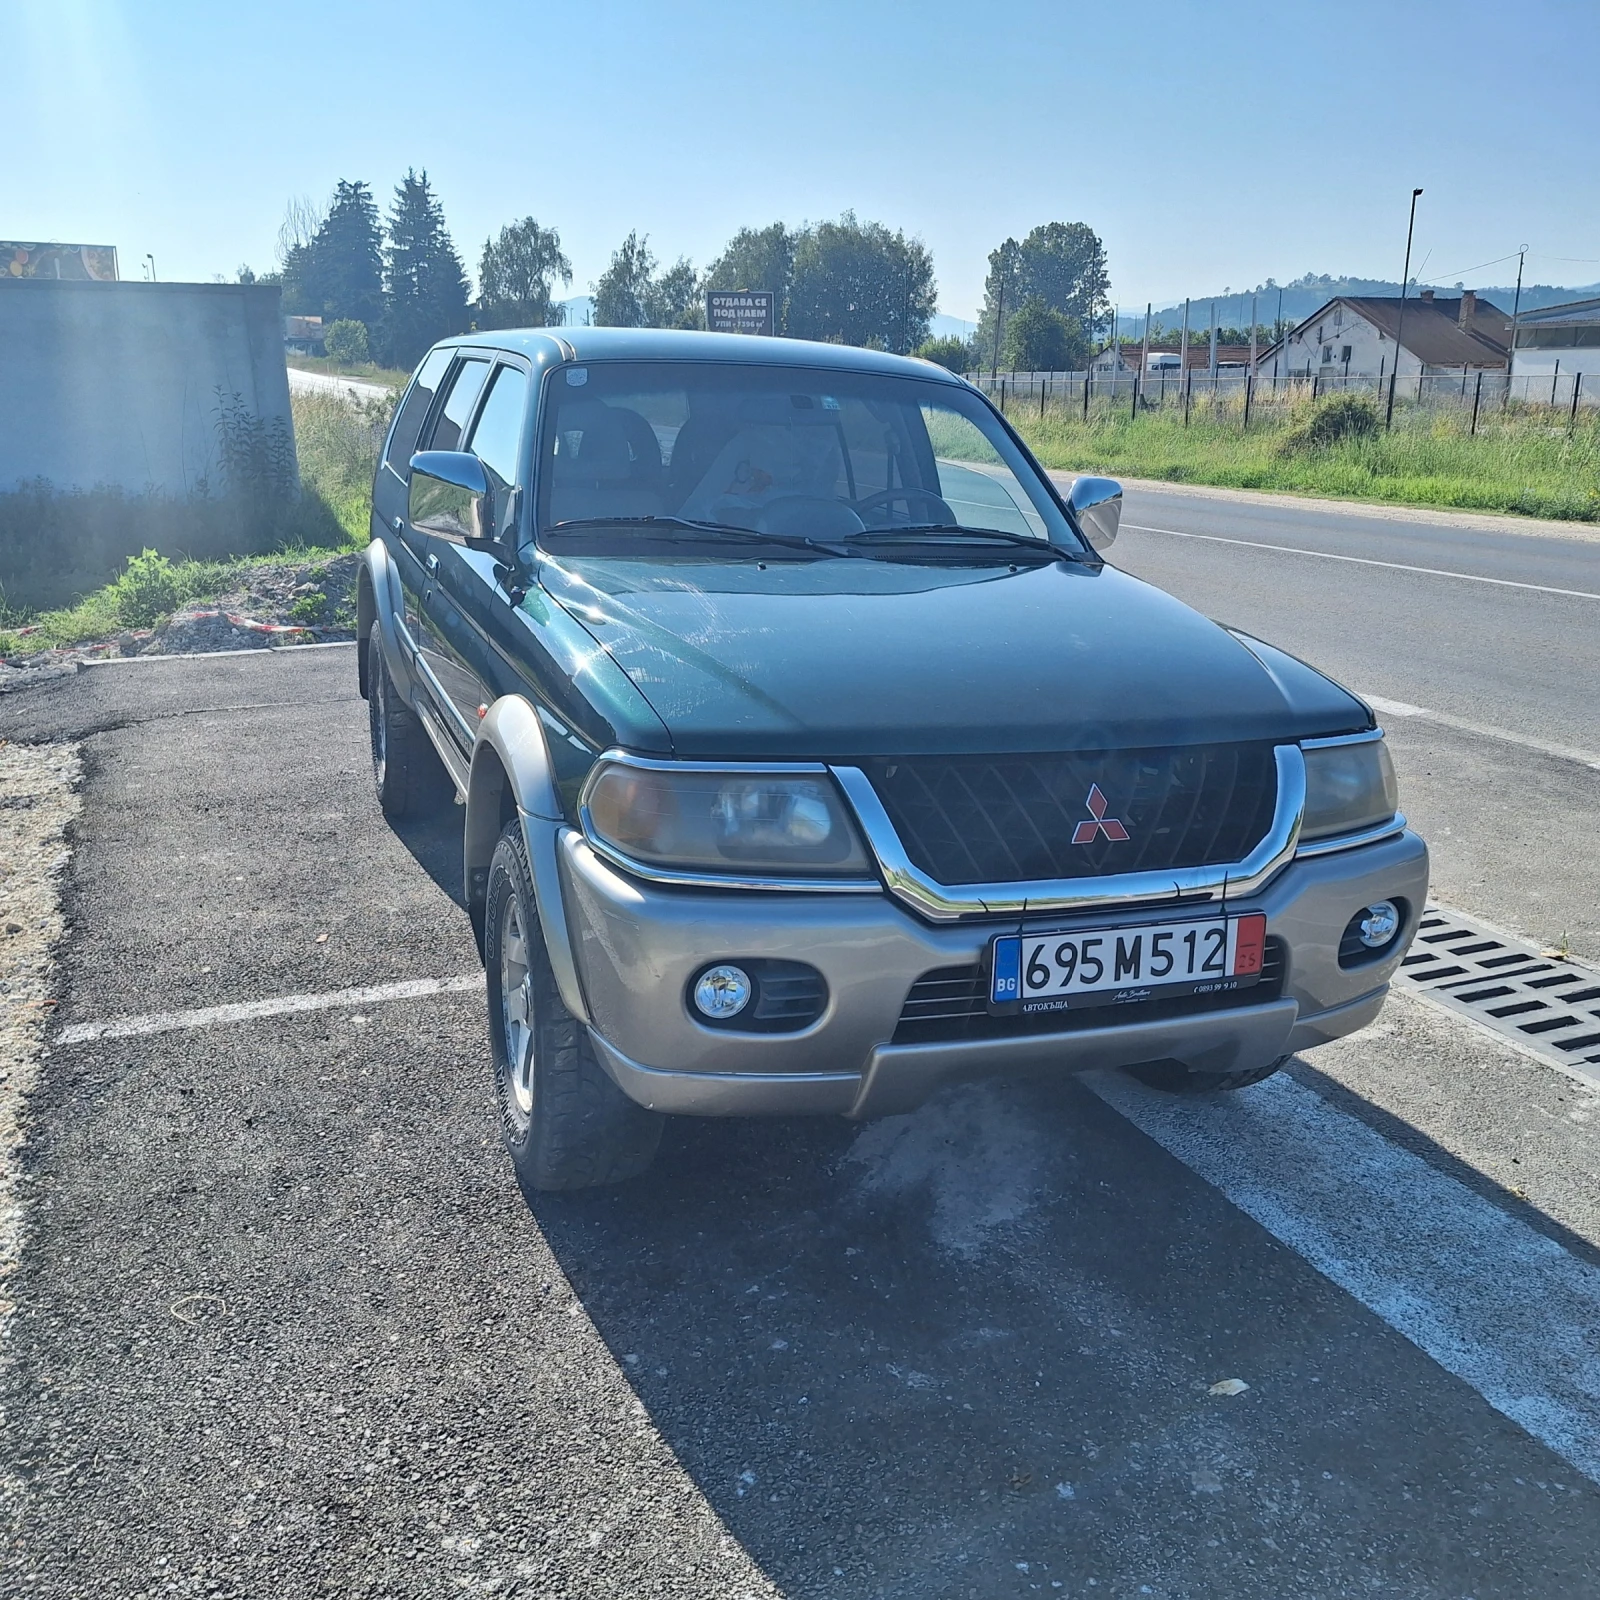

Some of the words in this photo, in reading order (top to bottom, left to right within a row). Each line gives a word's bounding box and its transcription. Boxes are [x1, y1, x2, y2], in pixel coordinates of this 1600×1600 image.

[712, 297, 753, 307] ОТДАВА
[754, 297, 767, 306] СЕ
[713, 308, 736, 318] ПОД
[736, 309, 766, 318] НАЕМ
[996, 976, 1016, 993] BG
